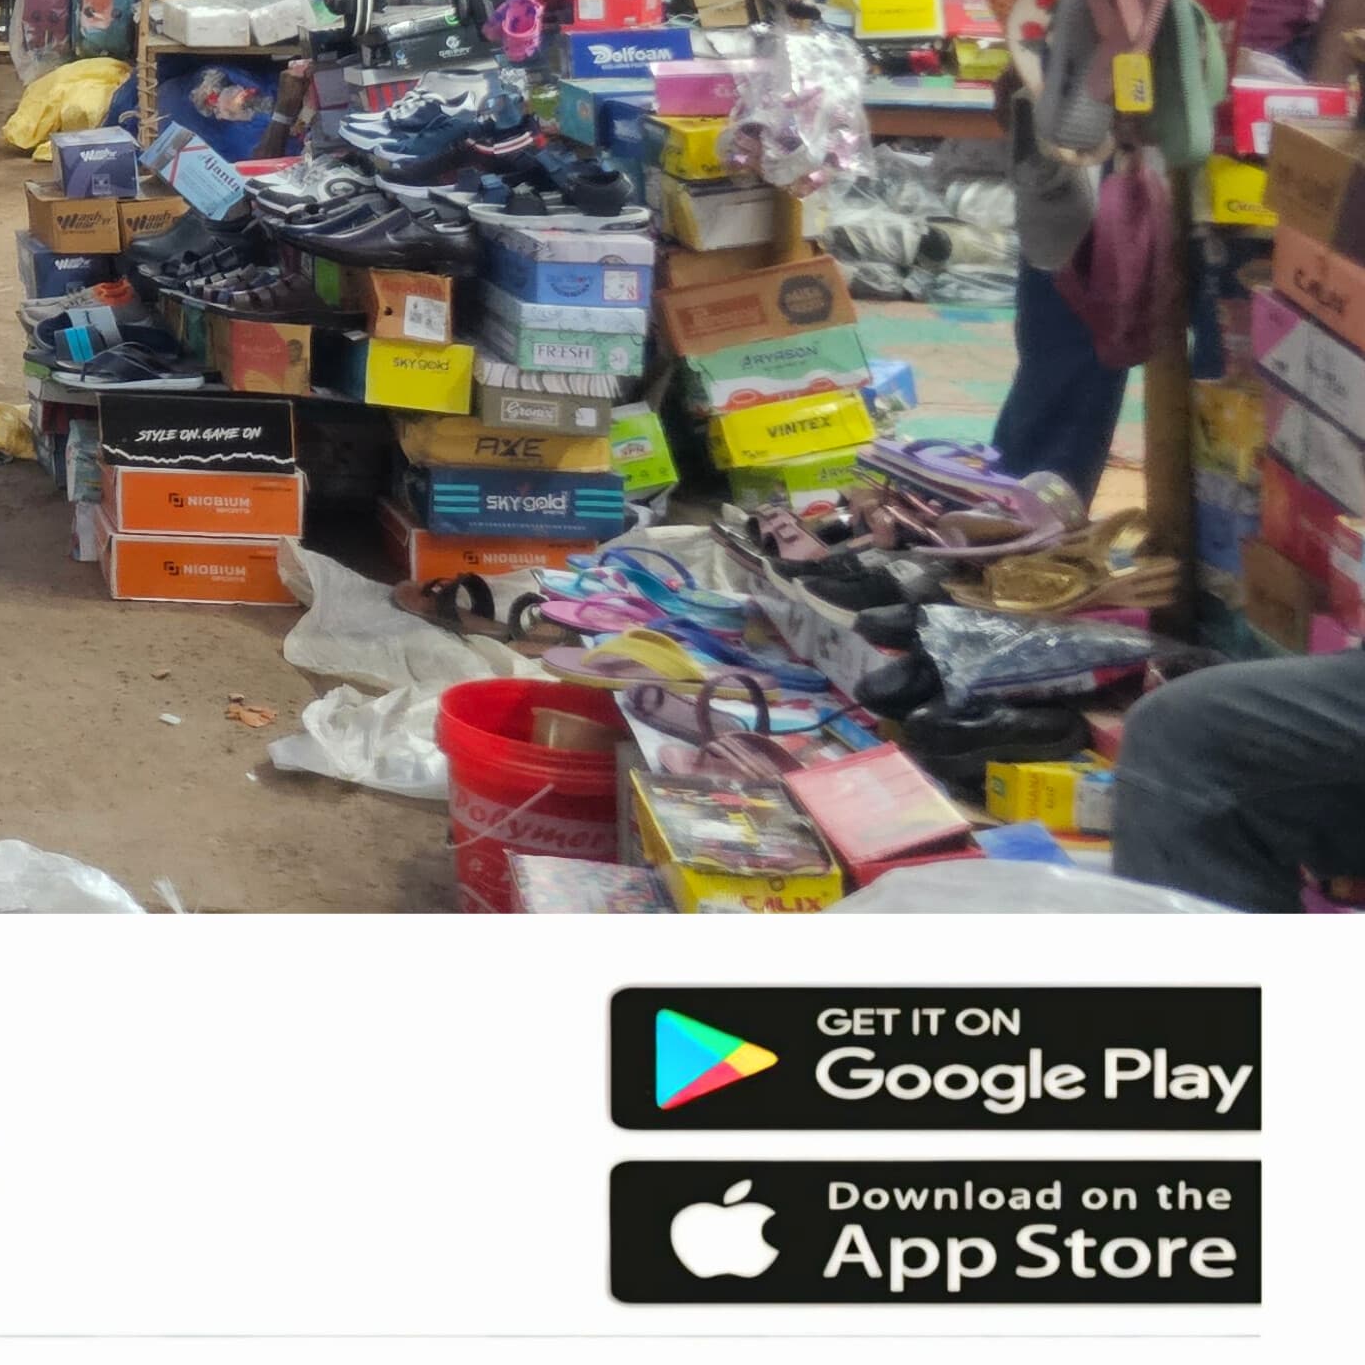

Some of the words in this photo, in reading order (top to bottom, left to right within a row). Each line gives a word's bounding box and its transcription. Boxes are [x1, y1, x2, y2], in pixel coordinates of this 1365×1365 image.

[588, 43, 673, 64] Dolfoam
[198, 152, 242, 193] Ajanta
[537, 344, 591, 359] FRESH
[134, 429, 173, 442] STYLE
[242, 426, 262, 441] ON
[765, 415, 832, 438] VINTEX
[474, 437, 549, 458] AXE
[187, 495, 251, 508] NIOBIUM
[482, 552, 547, 565] NIOBIUM
[183, 564, 246, 577] NIOBIUM
